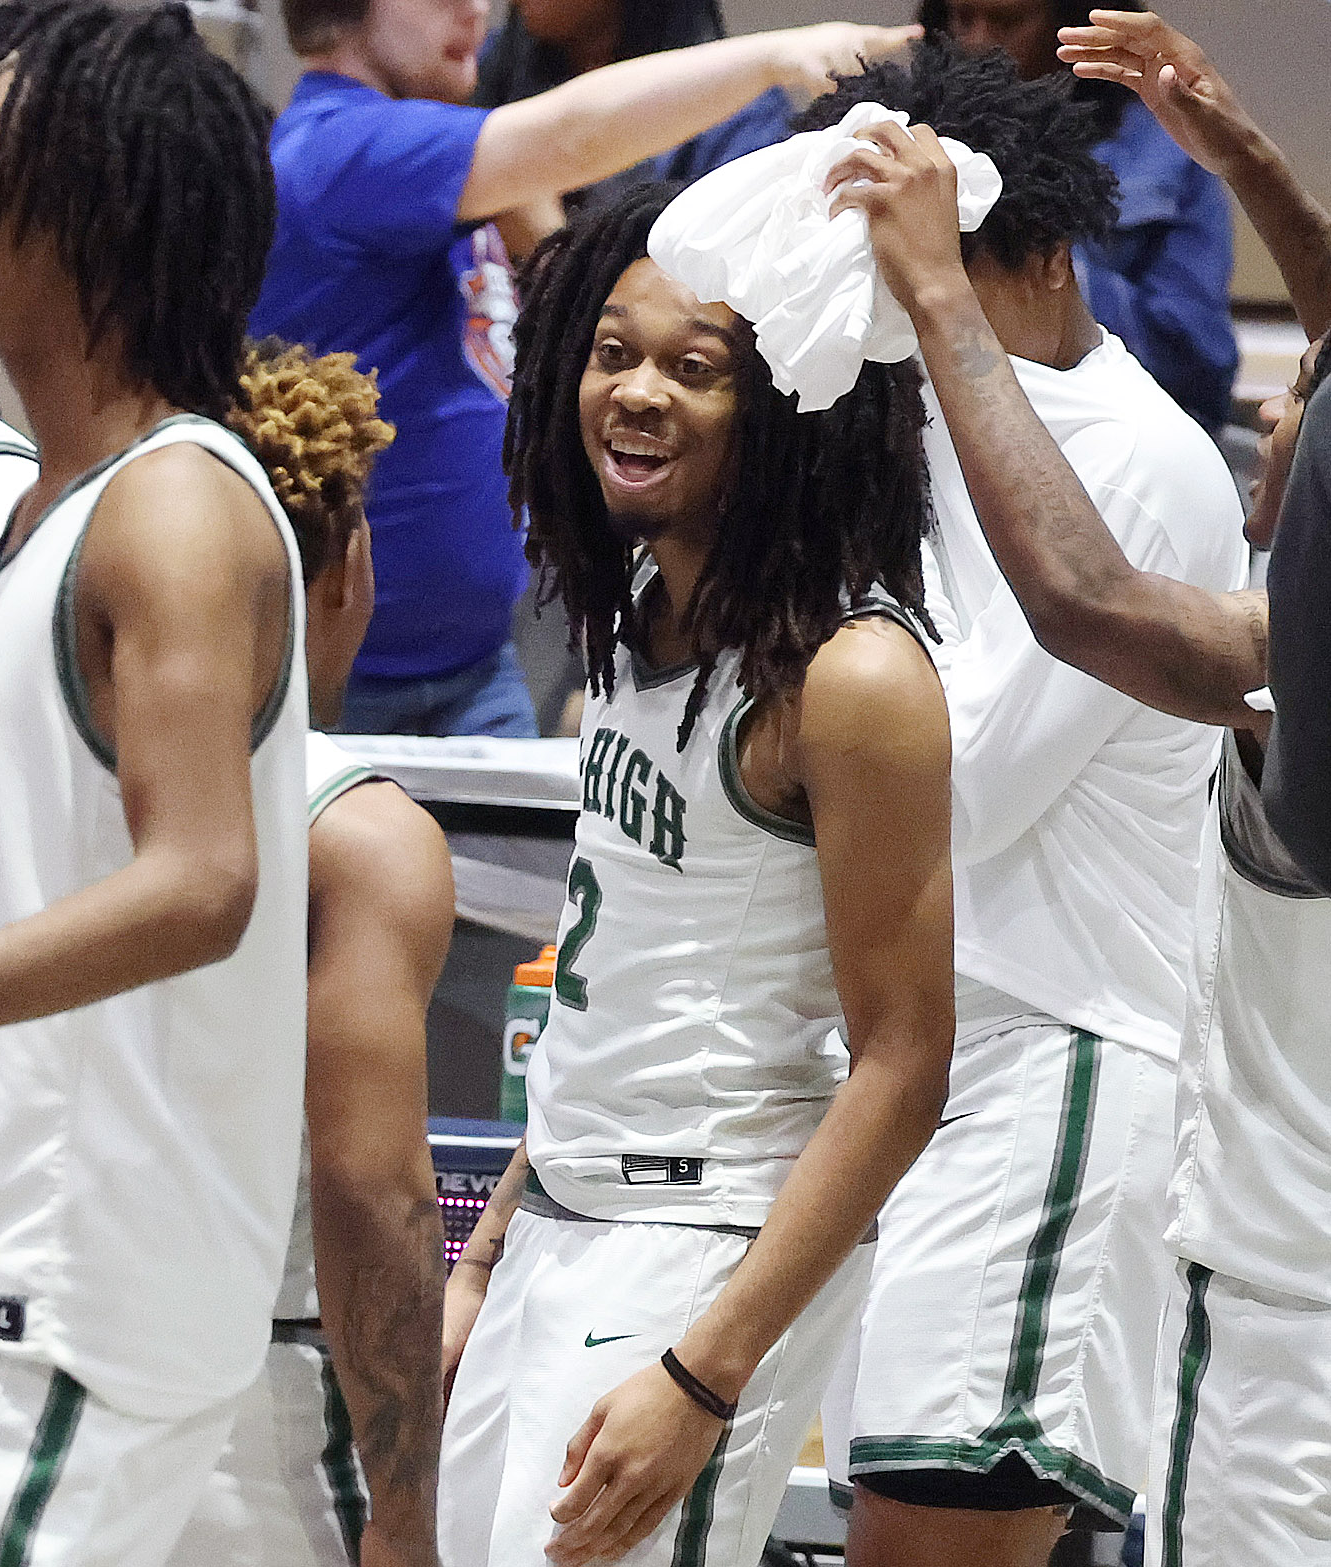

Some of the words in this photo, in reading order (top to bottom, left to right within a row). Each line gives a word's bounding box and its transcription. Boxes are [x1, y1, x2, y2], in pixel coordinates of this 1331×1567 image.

[555, 855, 603, 1013] 2
[503, 1017, 541, 1076] G
[678, 1158, 689, 1174] S
